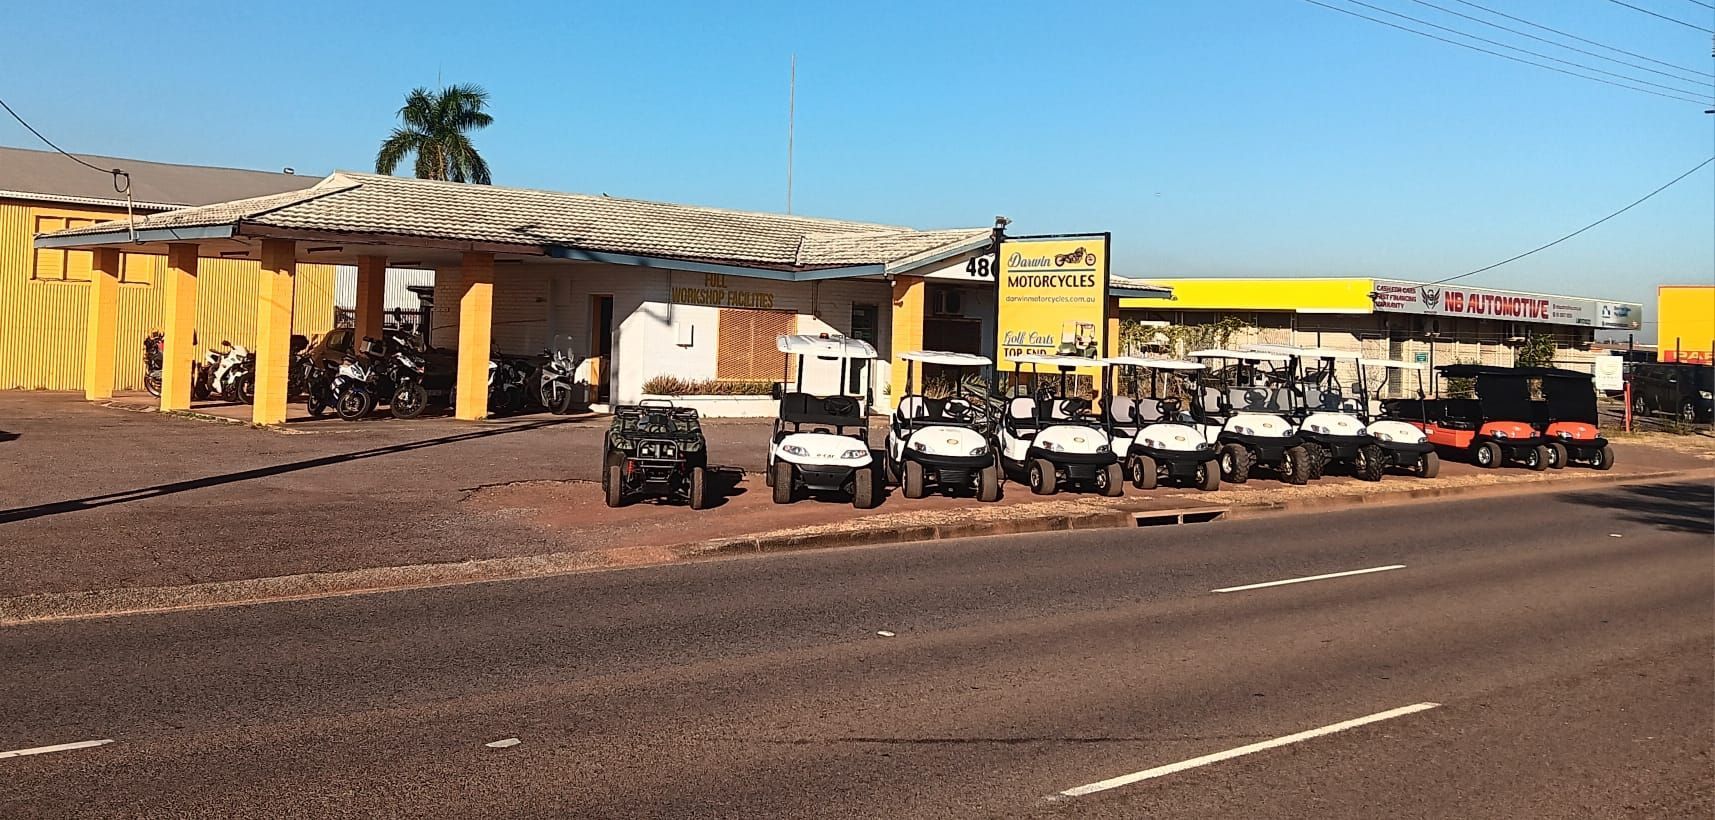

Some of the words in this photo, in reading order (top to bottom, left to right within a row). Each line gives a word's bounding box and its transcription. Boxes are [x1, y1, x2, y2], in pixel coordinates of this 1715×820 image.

[1008, 252, 1051, 268] Darwin
[704, 273, 727, 288] FULL
[1007, 275, 1095, 288] MOTORCYCLES
[671, 287, 725, 305] WORKSHOP
[727, 290, 774, 308] FACILITIES
[1005, 296, 1096, 304] darwinmotorcycles.com.au
[1444, 291, 1464, 312] NB
[1467, 293, 1549, 319] AUTOMOTIVE
[1003, 330, 1026, 345] Golf
[1029, 331, 1053, 344] Carts
[1004, 347, 1022, 357] TOP
[1026, 348, 1047, 356] END
